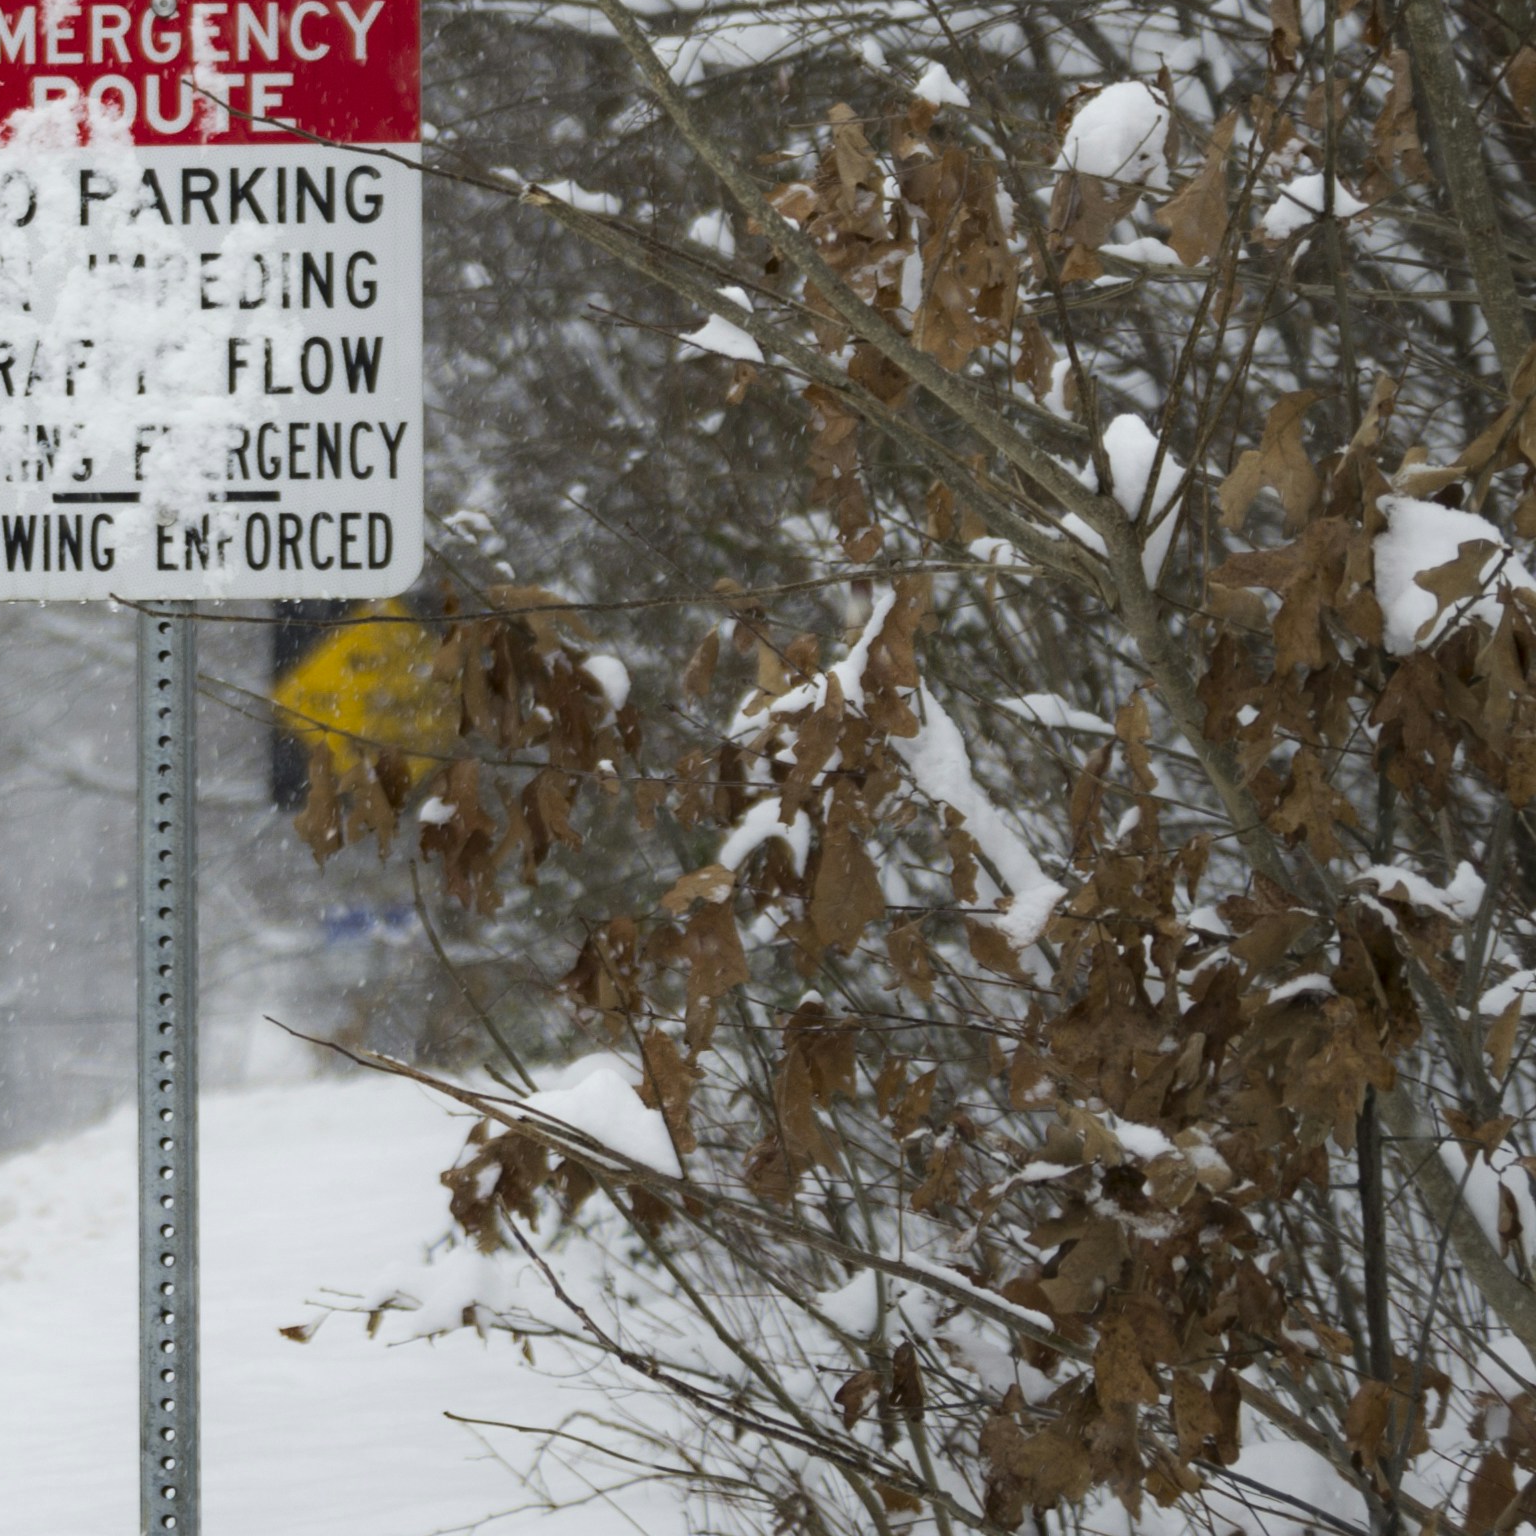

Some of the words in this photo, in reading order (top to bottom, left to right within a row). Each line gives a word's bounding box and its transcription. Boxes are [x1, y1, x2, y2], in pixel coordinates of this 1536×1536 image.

[88, 250, 379, 310] EDING
[228, 336, 384, 395] FLOW
[134, 421, 408, 481] ERGENCY
